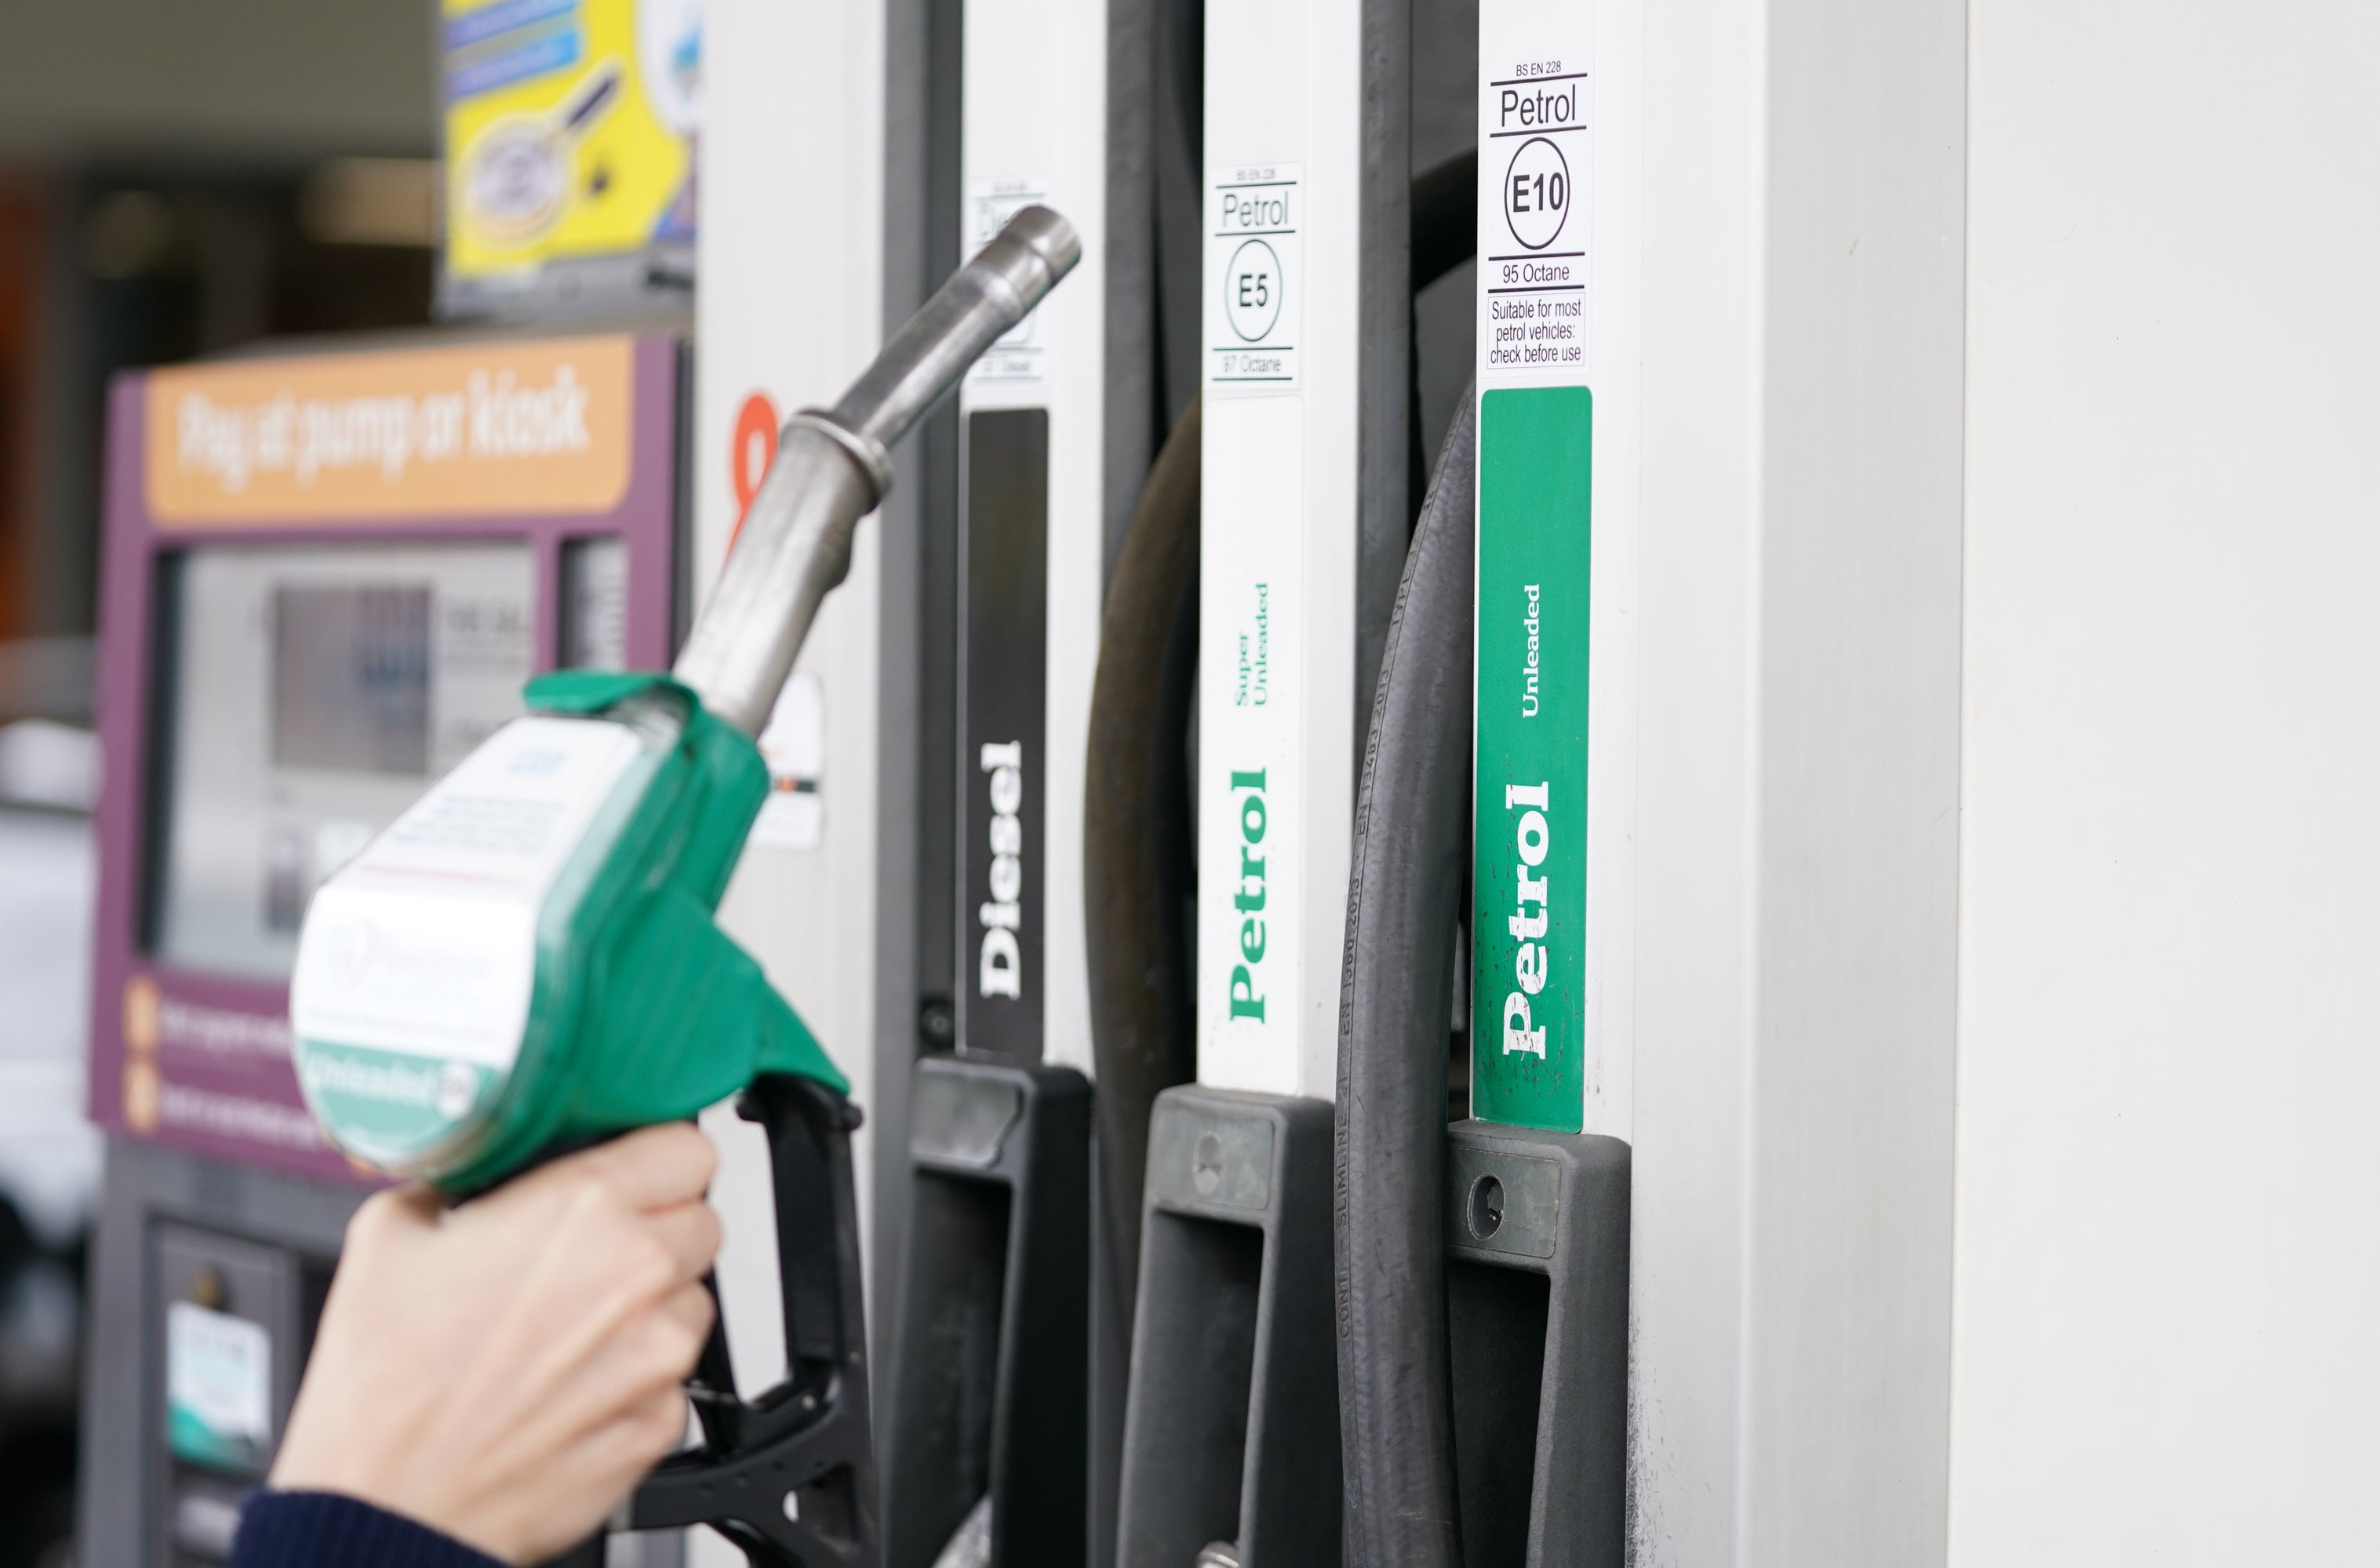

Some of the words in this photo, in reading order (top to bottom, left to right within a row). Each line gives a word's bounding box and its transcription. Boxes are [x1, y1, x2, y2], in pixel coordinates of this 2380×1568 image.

[1516, 64, 1528, 76] BS
[1530, 63, 1543, 75] EN
[1545, 60, 1561, 74] 228
[1501, 83, 1575, 127] Petrol
[1222, 191, 1288, 227] Petrol
[1512, 172, 1564, 213] E10
[1239, 274, 1268, 307] E5
[1503, 264, 1519, 284] 95
[1523, 263, 1570, 282] Octane
[1492, 300, 1534, 320] Suitable
[1538, 299, 1552, 318] for
[1555, 297, 1581, 317] most
[1497, 322, 1525, 345] petrol
[1530, 321, 1575, 340] vehicles:
[1241, 355, 1281, 372] Octane
[1490, 344, 1521, 364] check
[1524, 344, 1558, 362] before
[1562, 347, 1581, 361] use
[176, 393, 249, 494] Pay
[256, 387, 295, 471] at
[295, 394, 413, 491] pump
[420, 391, 464, 460] or
[468, 362, 590, 456] kiosk
[1255, 583, 1267, 706] Unleaded
[1522, 584, 1539, 719] Unleaded
[1235, 630, 1250, 706] Super
[979, 740, 1021, 1000] Diesel
[1229, 767, 1267, 1024] Petrol
[1502, 780, 1549, 1060] Petrol
[1340, 1003, 1351, 1036] EN
[1337, 1111, 1348, 1228] SLIMLINE
